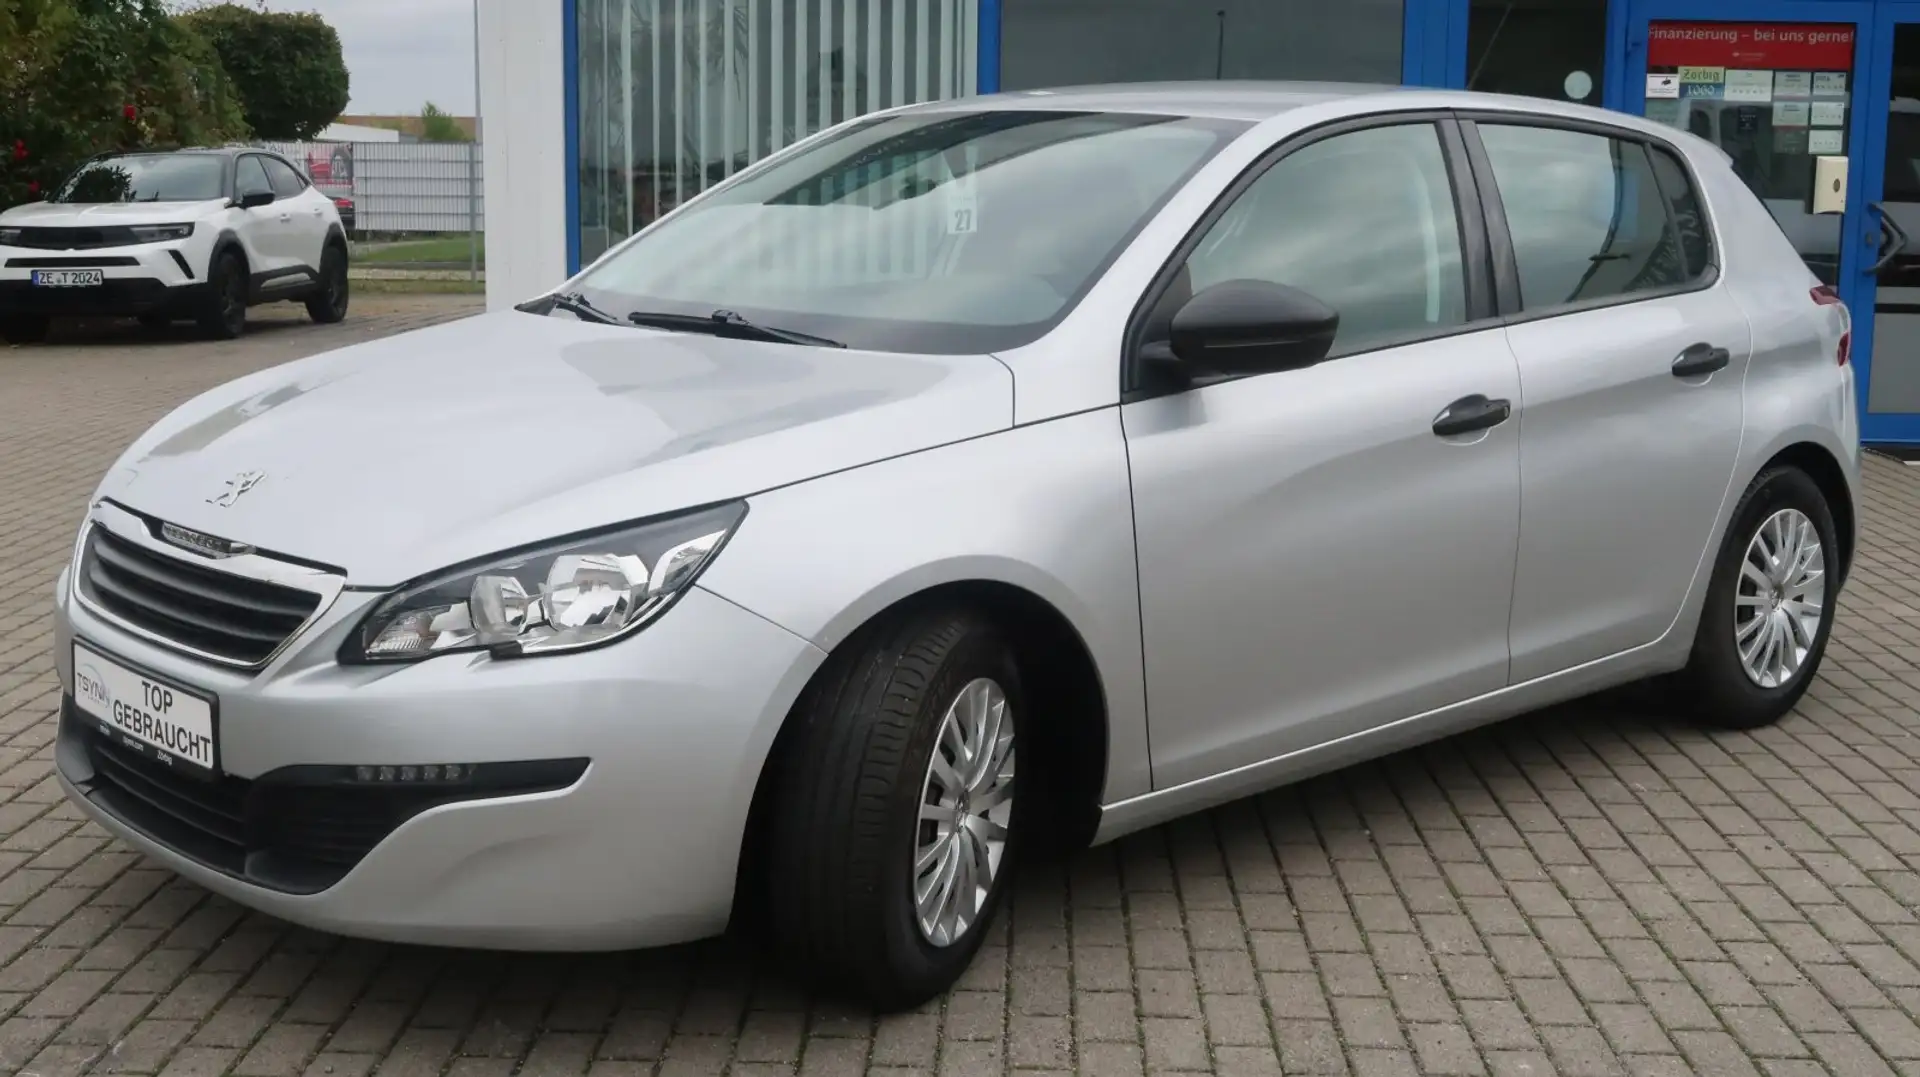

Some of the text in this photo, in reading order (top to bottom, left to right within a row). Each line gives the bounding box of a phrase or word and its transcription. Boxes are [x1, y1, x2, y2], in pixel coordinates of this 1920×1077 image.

[1754, 28, 1775, 41] bei
[1780, 31, 1804, 41] uns
[954, 209, 972, 232] 27
[39, 271, 100, 285] ZE T 2024
[142, 680, 173, 714] TOP
[113, 700, 211, 763] GEBRAUCHT
